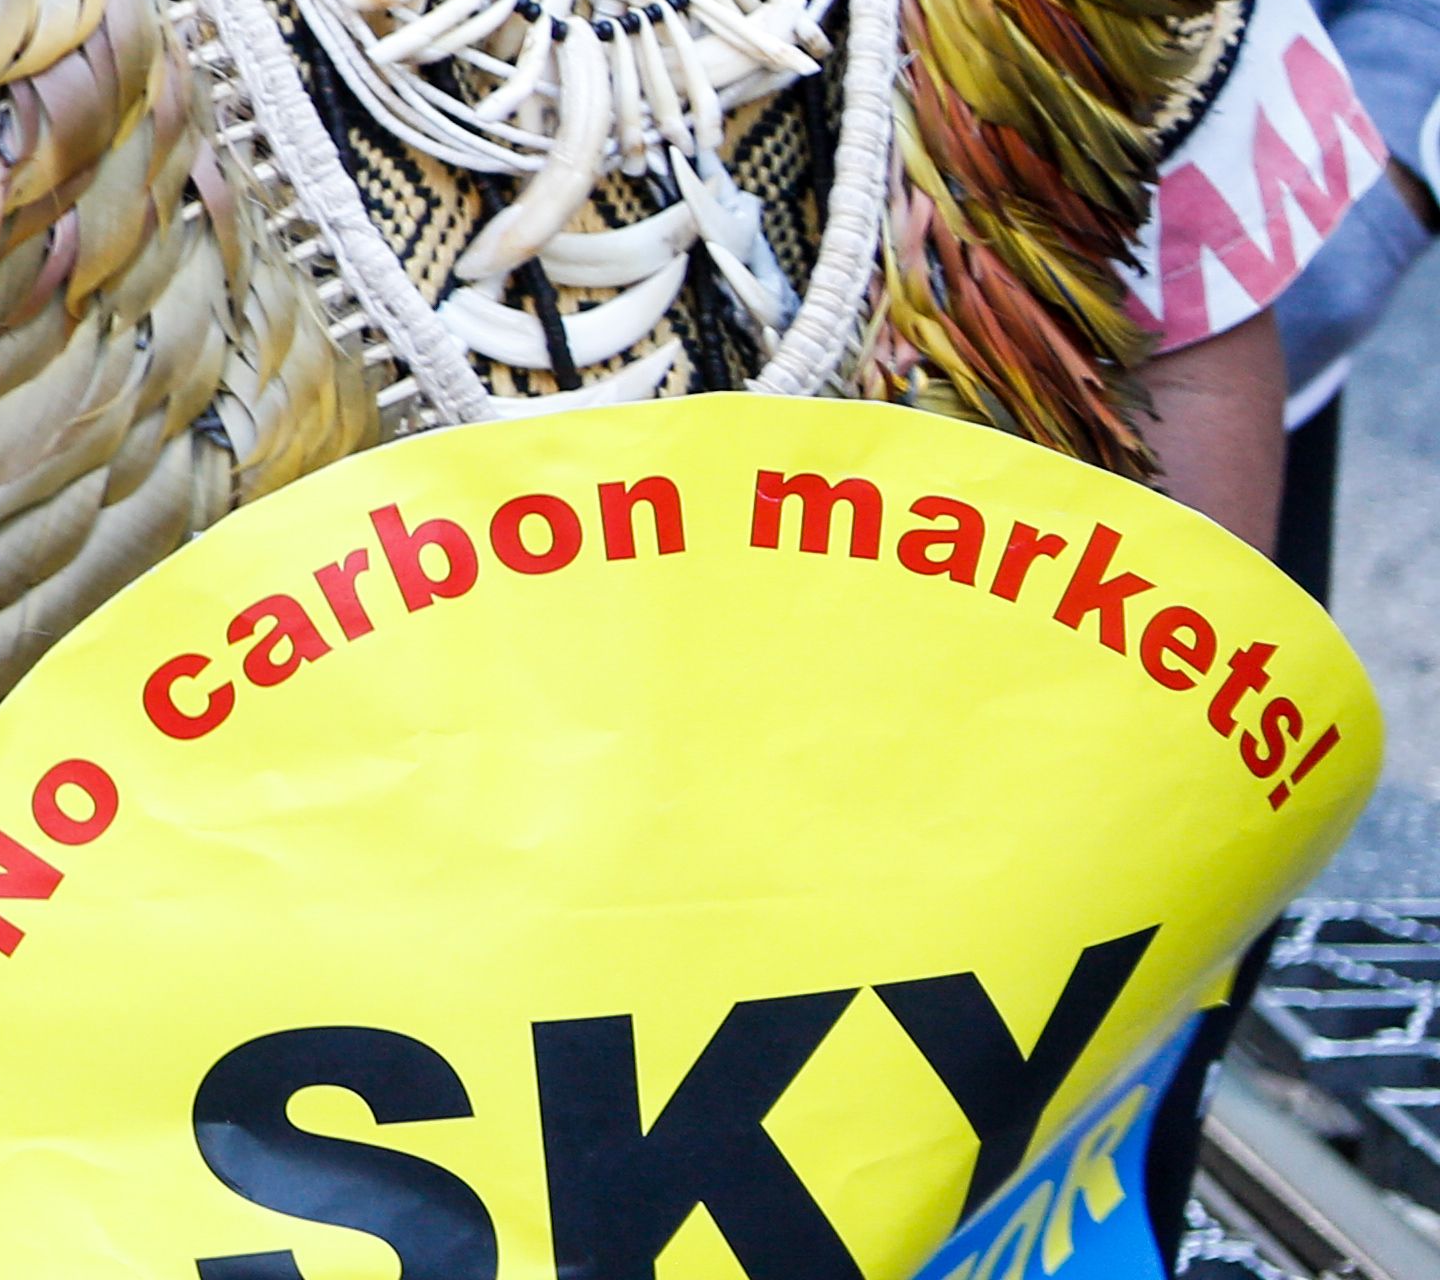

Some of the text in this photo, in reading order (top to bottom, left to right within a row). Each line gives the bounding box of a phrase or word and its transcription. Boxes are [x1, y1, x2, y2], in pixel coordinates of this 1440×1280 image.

[142, 474, 686, 741] carbon
[750, 469, 1341, 811] markets!
[191, 924, 1162, 1280] SKY
